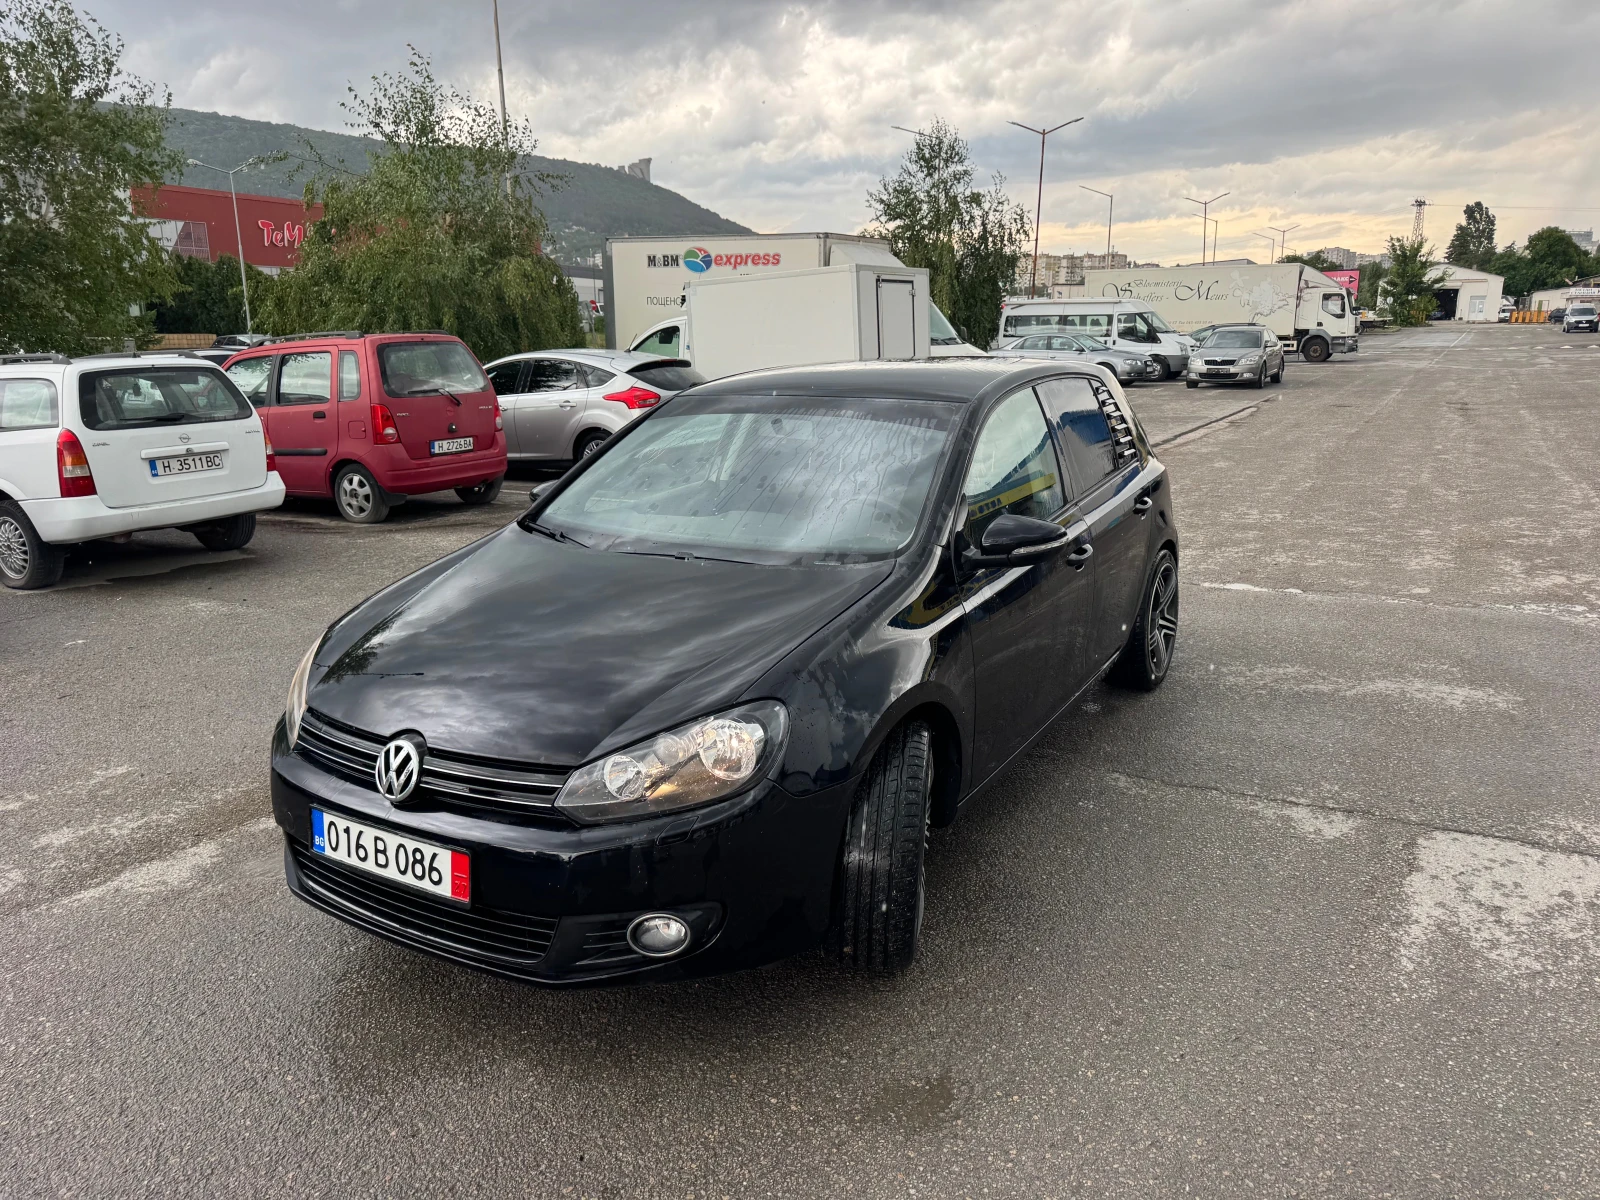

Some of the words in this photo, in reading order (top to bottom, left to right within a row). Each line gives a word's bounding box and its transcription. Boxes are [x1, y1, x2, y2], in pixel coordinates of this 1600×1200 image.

[258, 219, 313, 249] TeM
[714, 253, 781, 270] express
[1130, 278, 1183, 288] Bloemisterij
[1174, 279, 1230, 301] Meurs
[646, 296, 682, 307] ПОЩЕНС
[177, 457, 204, 471] 3511
[315, 836, 325, 847] BG
[328, 821, 369, 863] 016
[395, 844, 443, 886] 086
